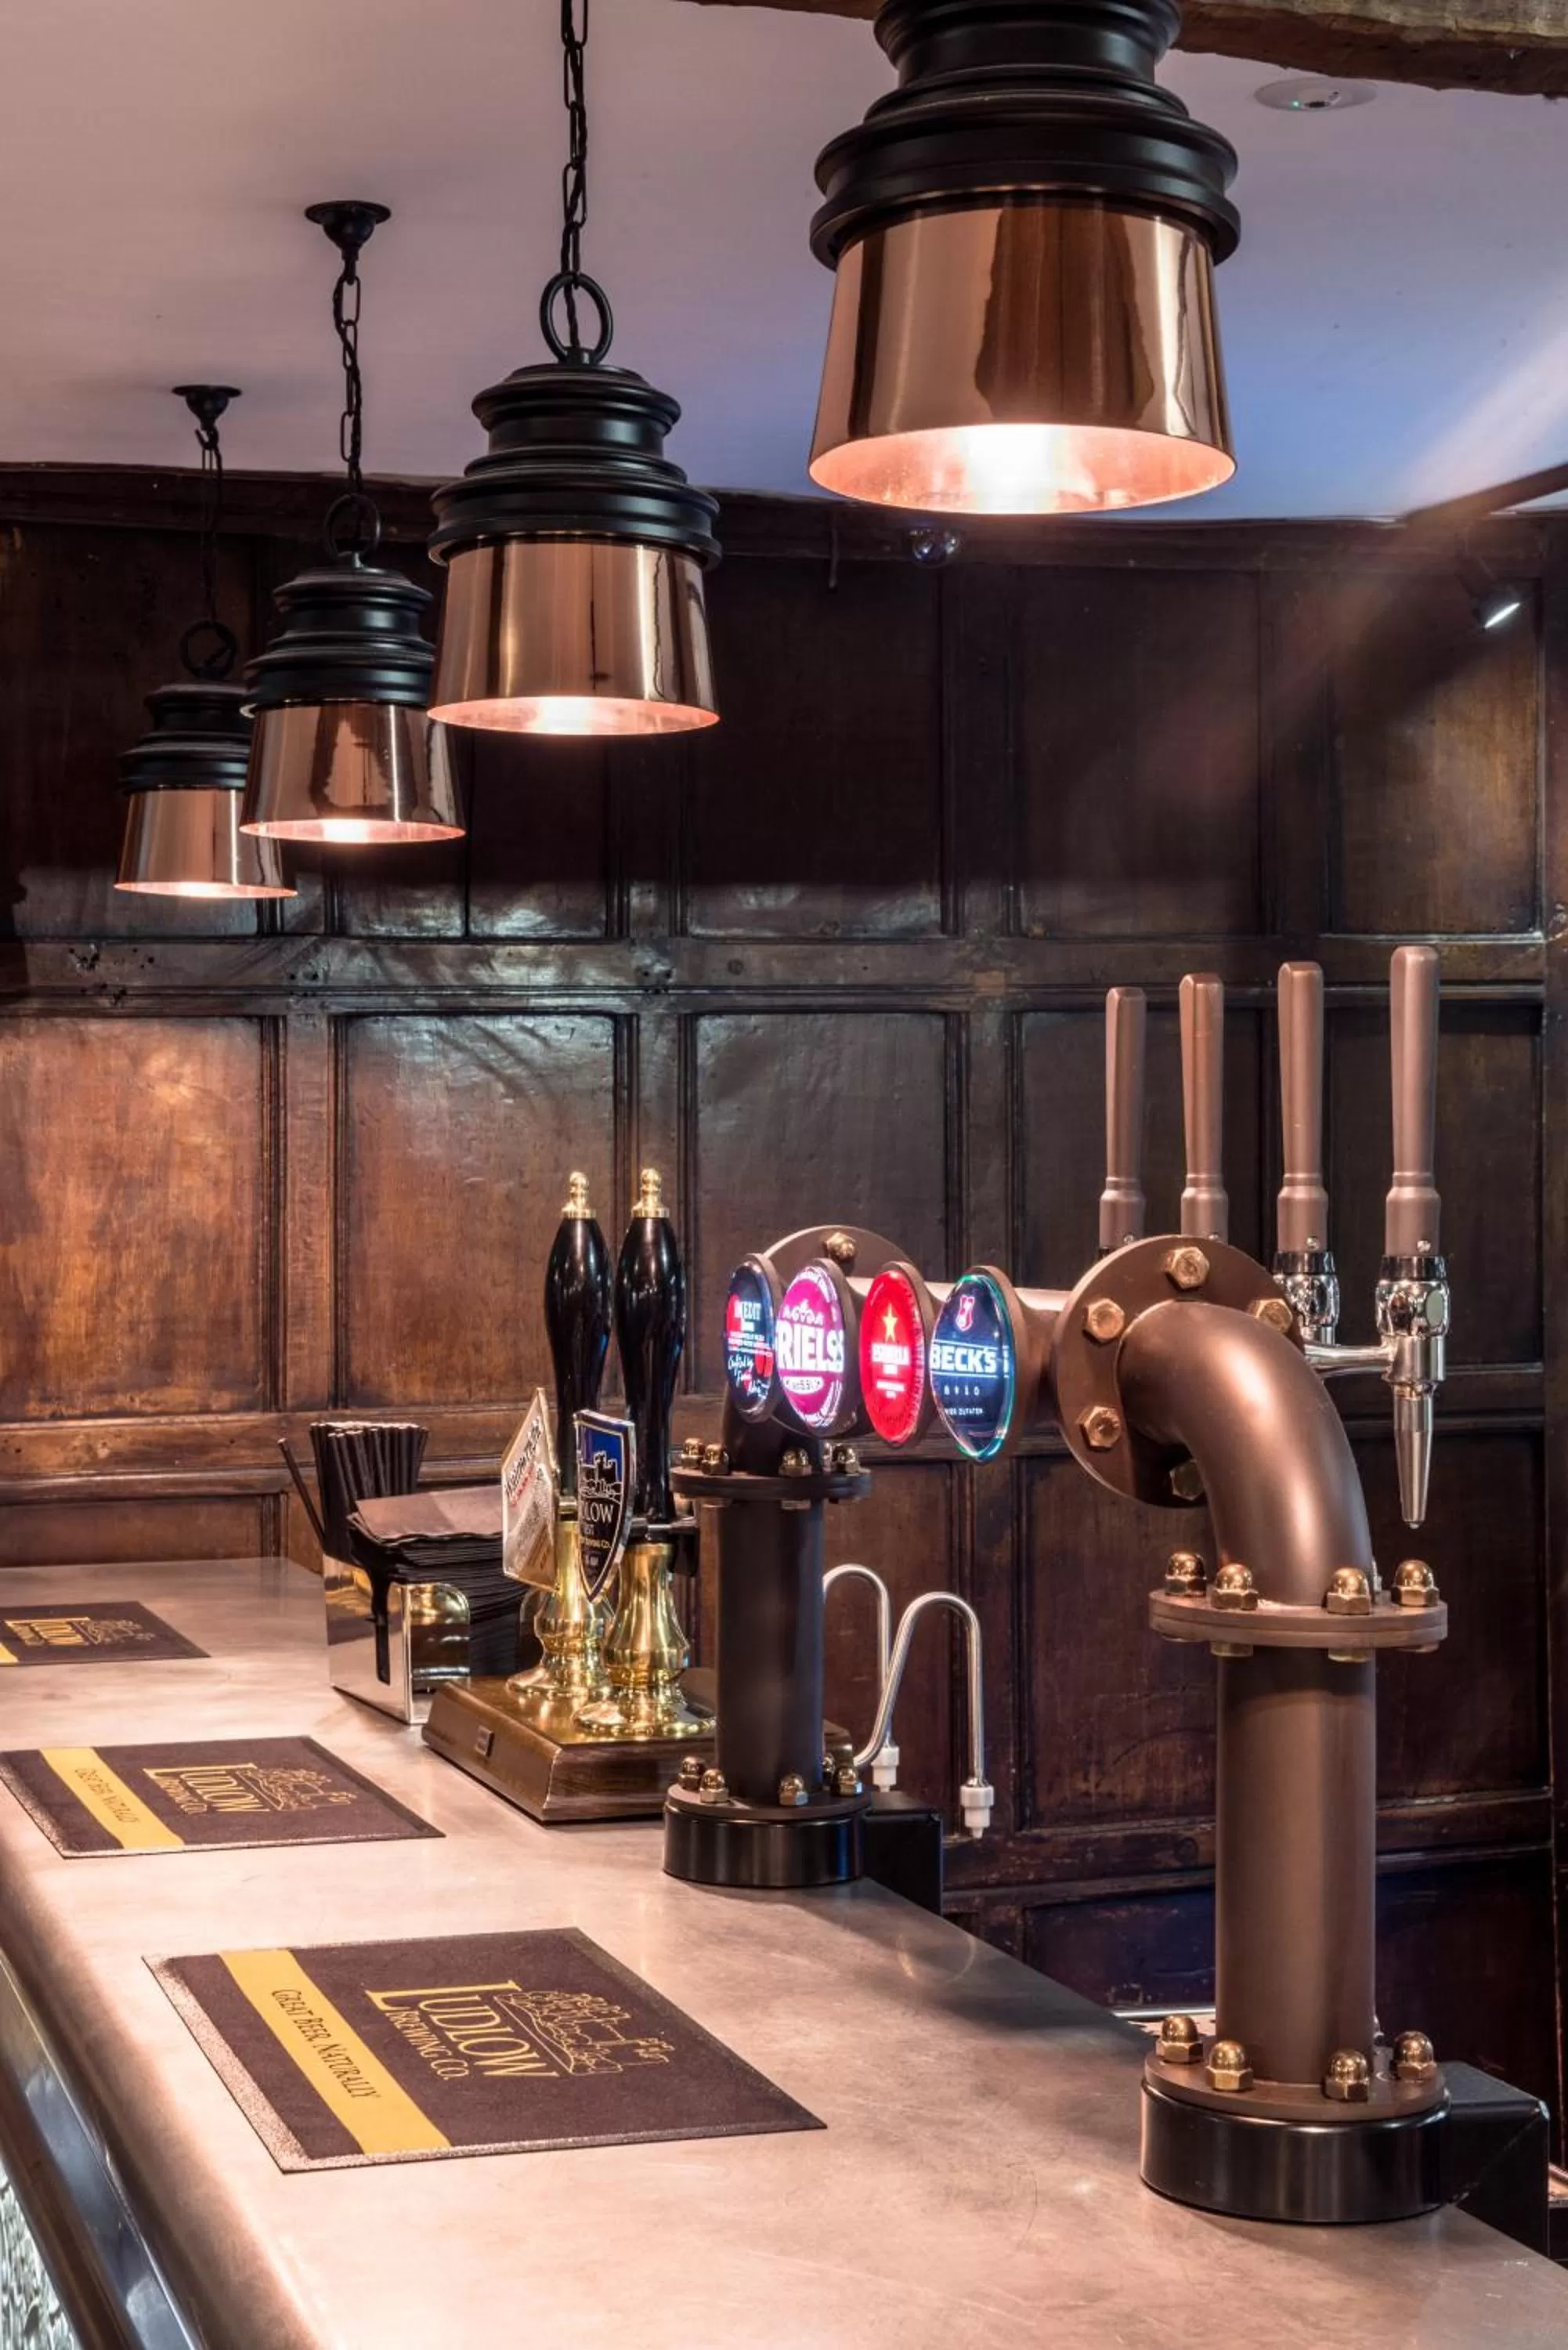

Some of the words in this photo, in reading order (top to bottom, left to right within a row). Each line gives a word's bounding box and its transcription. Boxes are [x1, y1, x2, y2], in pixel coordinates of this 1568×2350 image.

[271, 1989, 313, 2016] GREAT
[293, 2017, 332, 2041] BEER
[313, 2043, 381, 2098] NATURALLY
[364, 1979, 560, 2077] LUDLOW
[385, 2010, 452, 2059] BREWING
